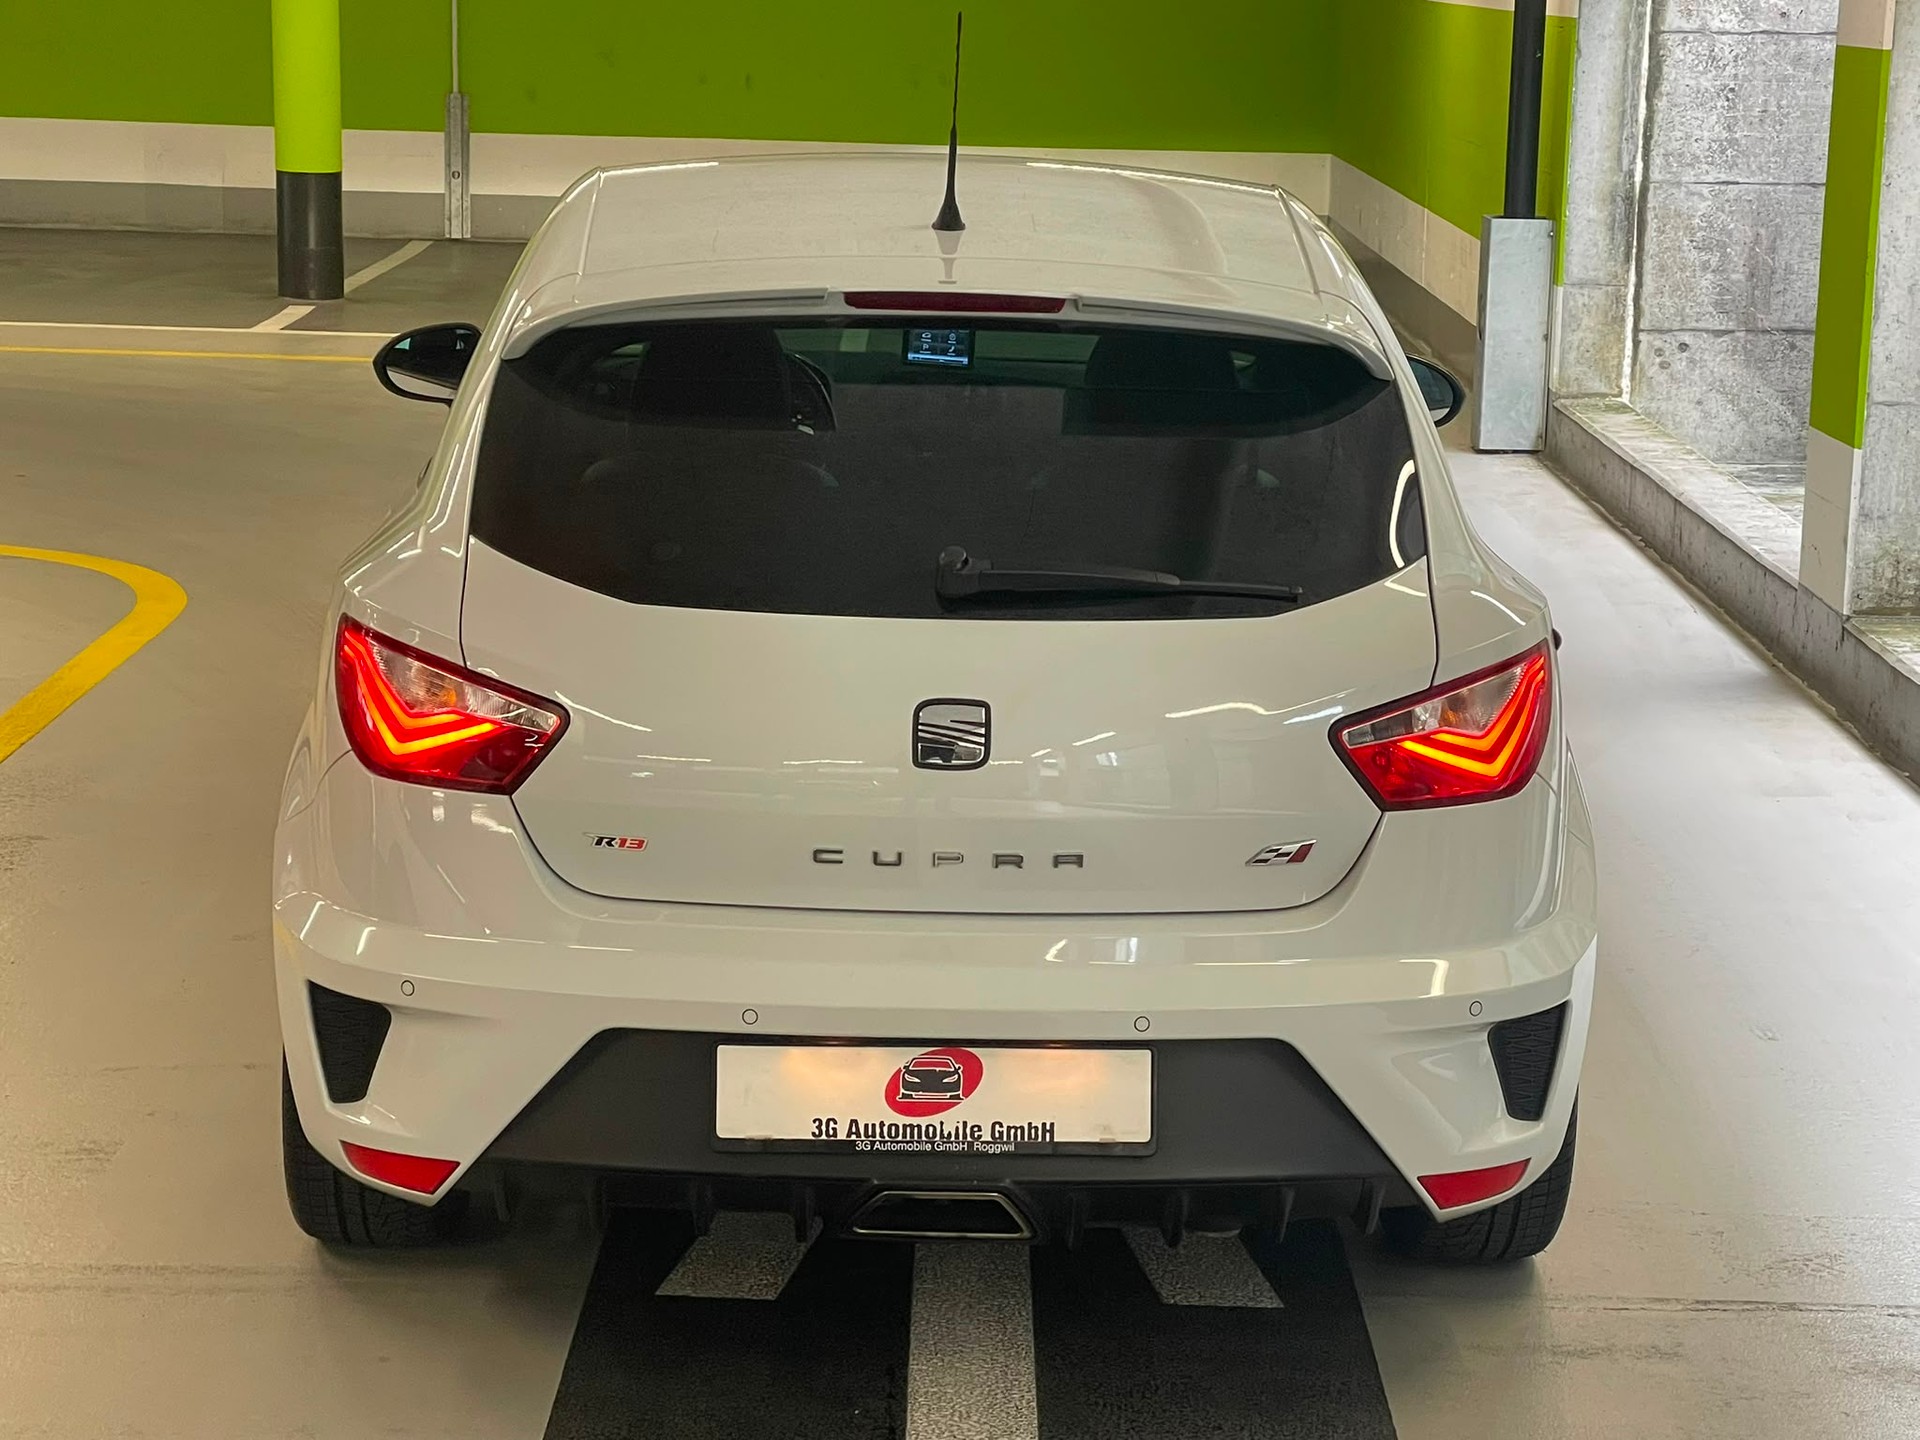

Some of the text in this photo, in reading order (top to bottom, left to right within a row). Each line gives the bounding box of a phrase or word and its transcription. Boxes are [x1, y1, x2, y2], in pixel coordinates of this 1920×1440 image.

[594, 836, 646, 849] R13
[812, 848, 1084, 869] CUPRA
[811, 1117, 1055, 1142] 3G Automobile GmbH
[855, 1140, 1015, 1154] 3G Automobile GmbH Roggwil
